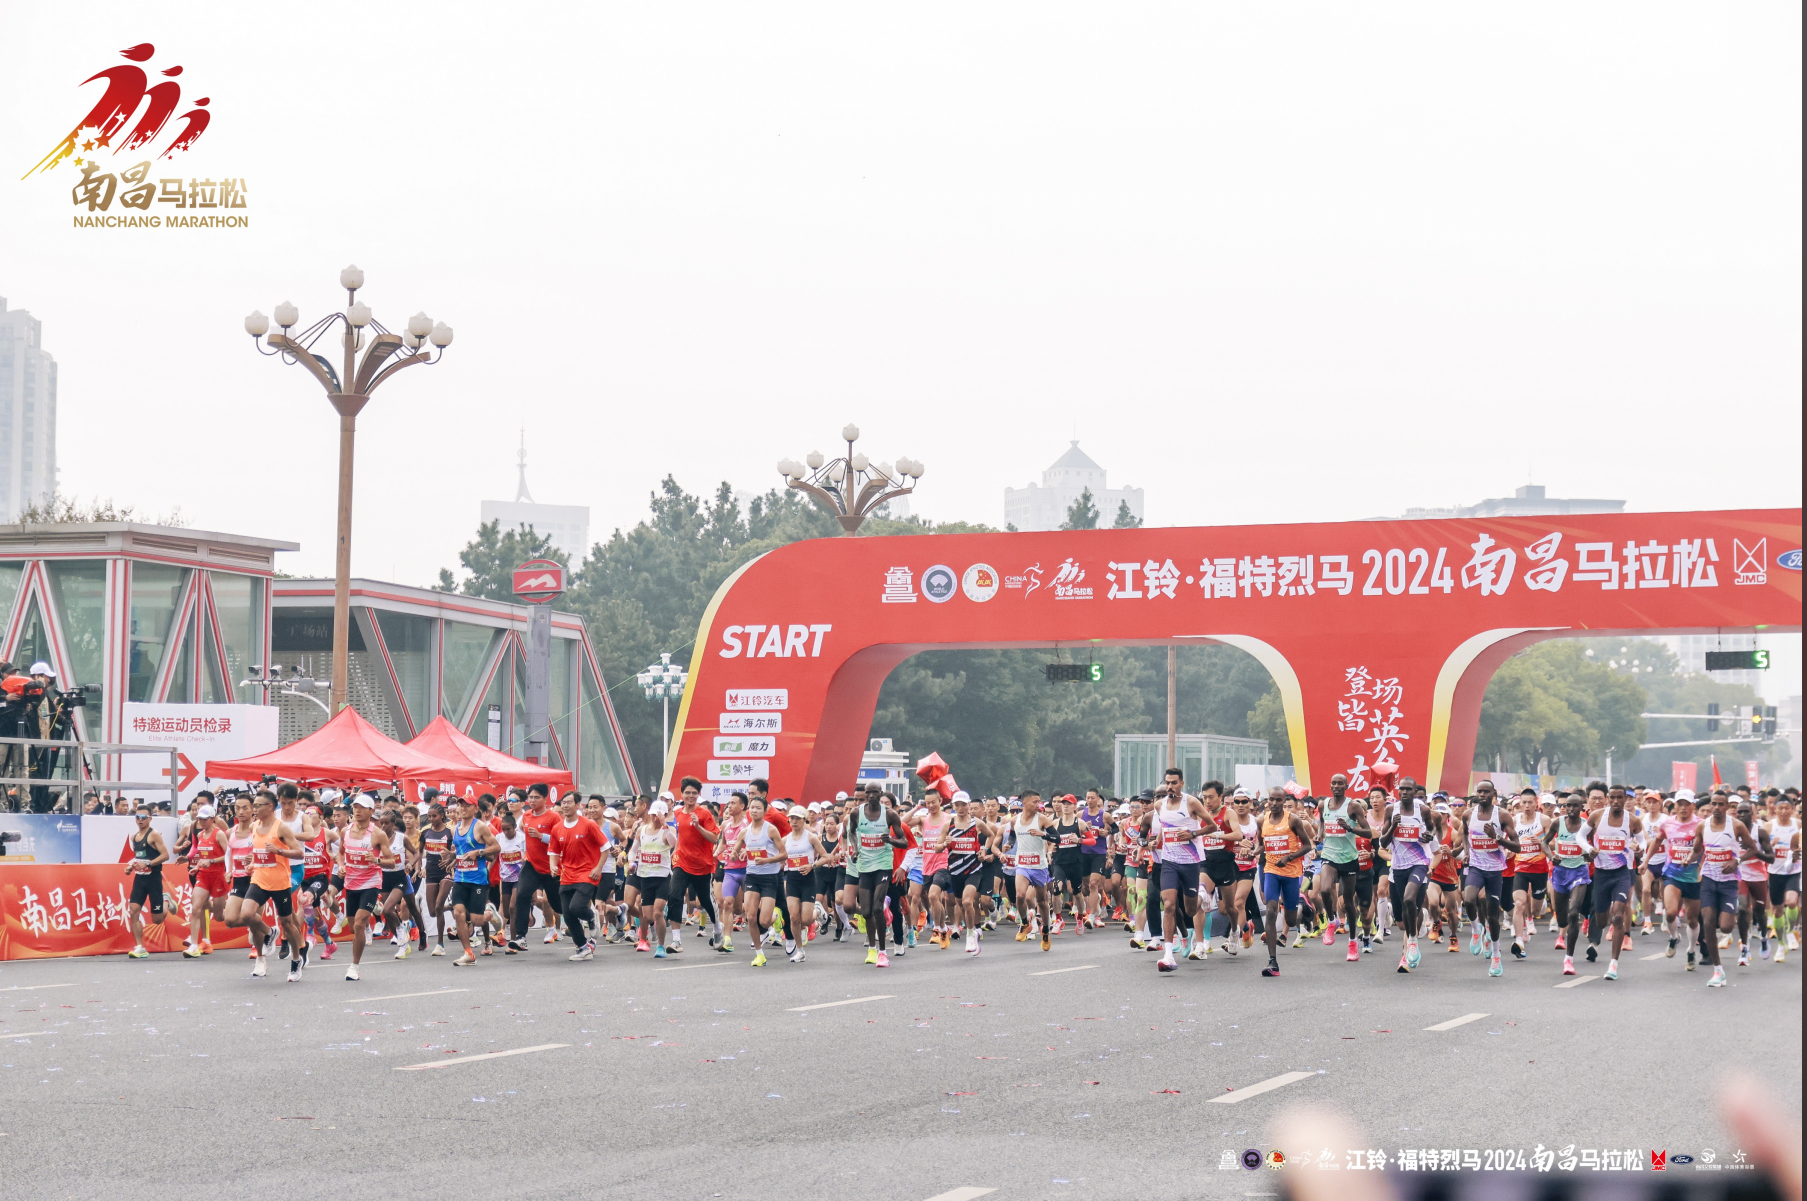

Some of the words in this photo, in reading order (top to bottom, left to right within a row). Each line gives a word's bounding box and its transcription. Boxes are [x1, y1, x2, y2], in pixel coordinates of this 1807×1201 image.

[1106, 555, 1354, 600] 江铃·福特烈马
[1362, 548, 1454, 596] 2024
[1461, 532, 1720, 596] 南昌马拉松
[1735, 572, 1766, 585] JMC
[718, 624, 832, 658] START
[740, 696, 784, 706] 江铃汽车
[133, 717, 232, 733] 特邀运动员检录
[744, 718, 778, 728] 海尔斯
[748, 742, 769, 751] 魔力
[732, 764, 754, 776] 蒙牛
